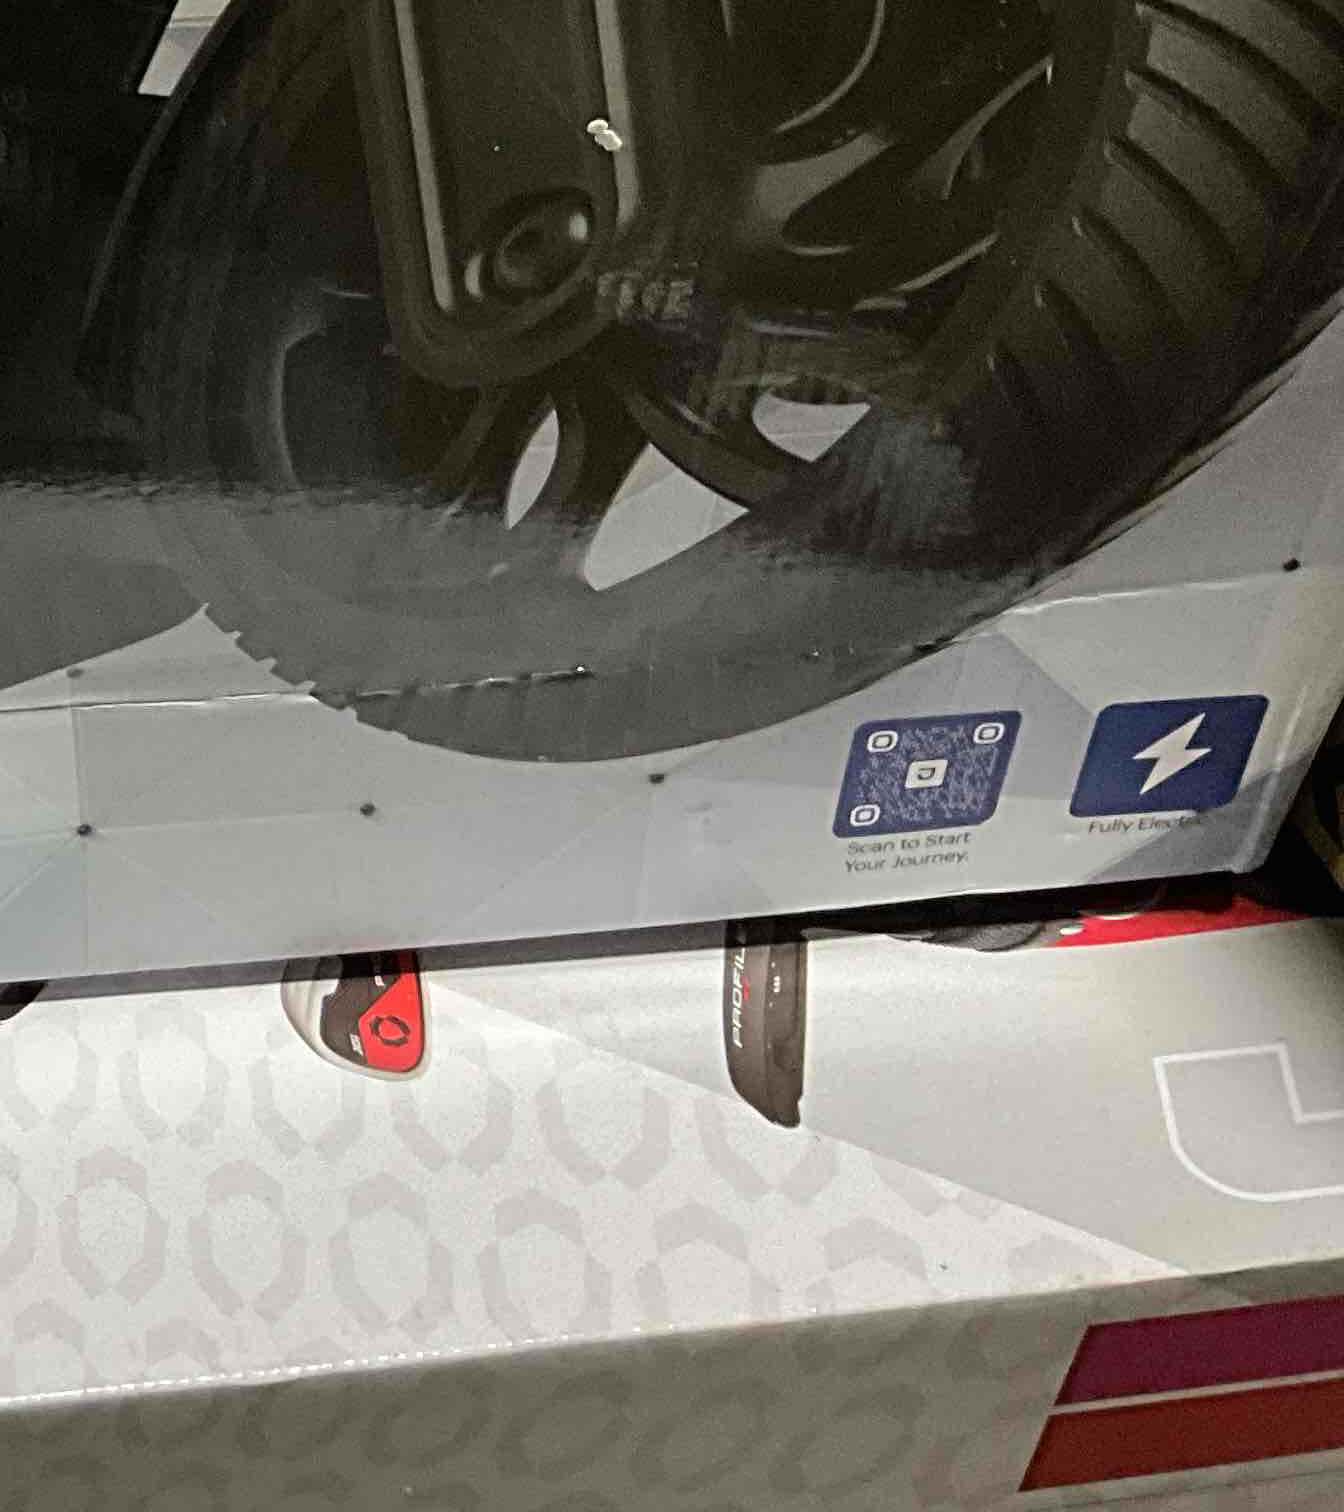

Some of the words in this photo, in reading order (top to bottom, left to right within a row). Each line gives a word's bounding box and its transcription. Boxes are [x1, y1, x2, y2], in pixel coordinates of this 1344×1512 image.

[1088, 818, 1132, 835] Fully
[847, 839, 897, 853] Scan
[901, 835, 919, 851] to
[926, 831, 971, 851] Start
[845, 856, 886, 873] Your
